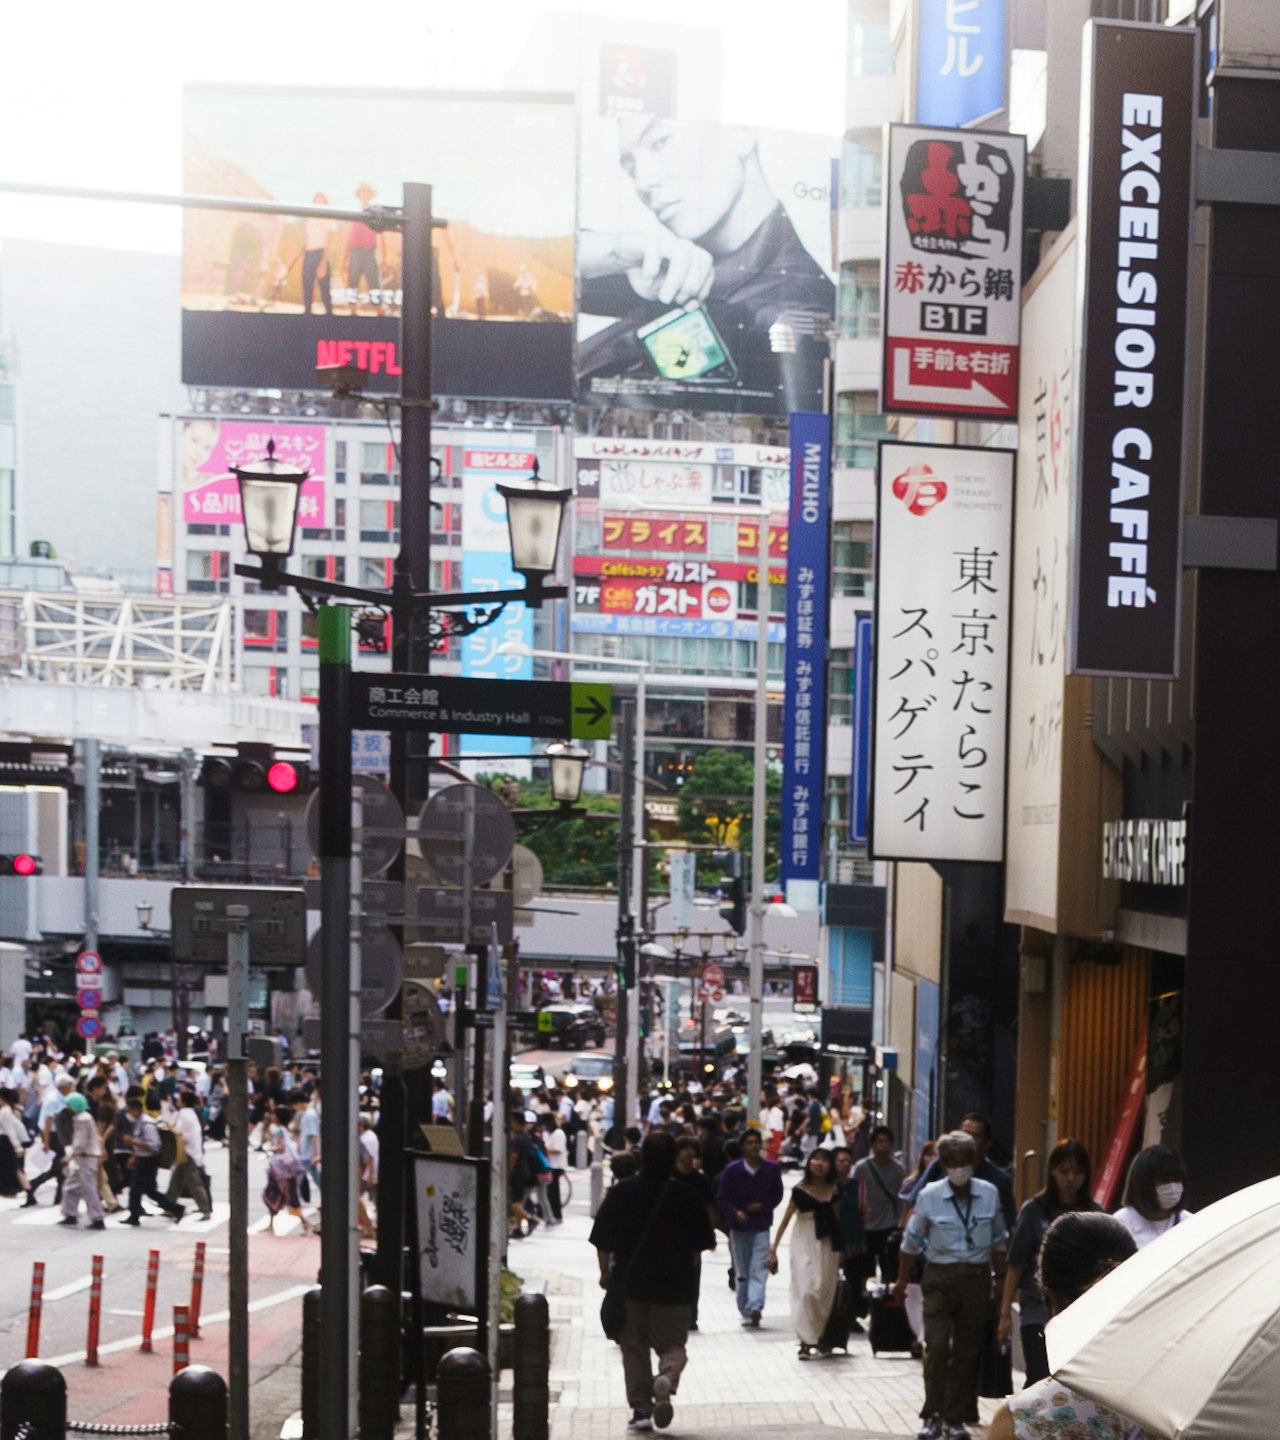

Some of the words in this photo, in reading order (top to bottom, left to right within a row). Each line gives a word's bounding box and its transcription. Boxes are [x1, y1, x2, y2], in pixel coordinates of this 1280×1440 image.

[1114, 92, 1164, 409] EXCELSIOR
[894, 261, 1014, 301] 赤から鍋
[924, 305, 983, 332] B1F
[316, 339, 402, 376] NETFL
[914, 347, 1010, 375] 手前を右折
[578, 469, 599, 486] 9F
[802, 442, 821, 523] MIZUHO
[1107, 427, 1157, 608] CAFFÉ
[665, 562, 717, 582] ガスト
[575, 586, 600, 604] 7F
[634, 586, 699, 615] ガスト
[369, 686, 440, 706] 商工会館
[950, 546, 999, 820] 東京たらこ
[369, 705, 437, 721] Commerce
[439, 709, 449, 721] &
[452, 710, 503, 727] Industry
[505, 712, 530, 725] Hall
[888, 606, 939, 832] スパゲティ
[791, 786, 809, 867] みずほ銀行
